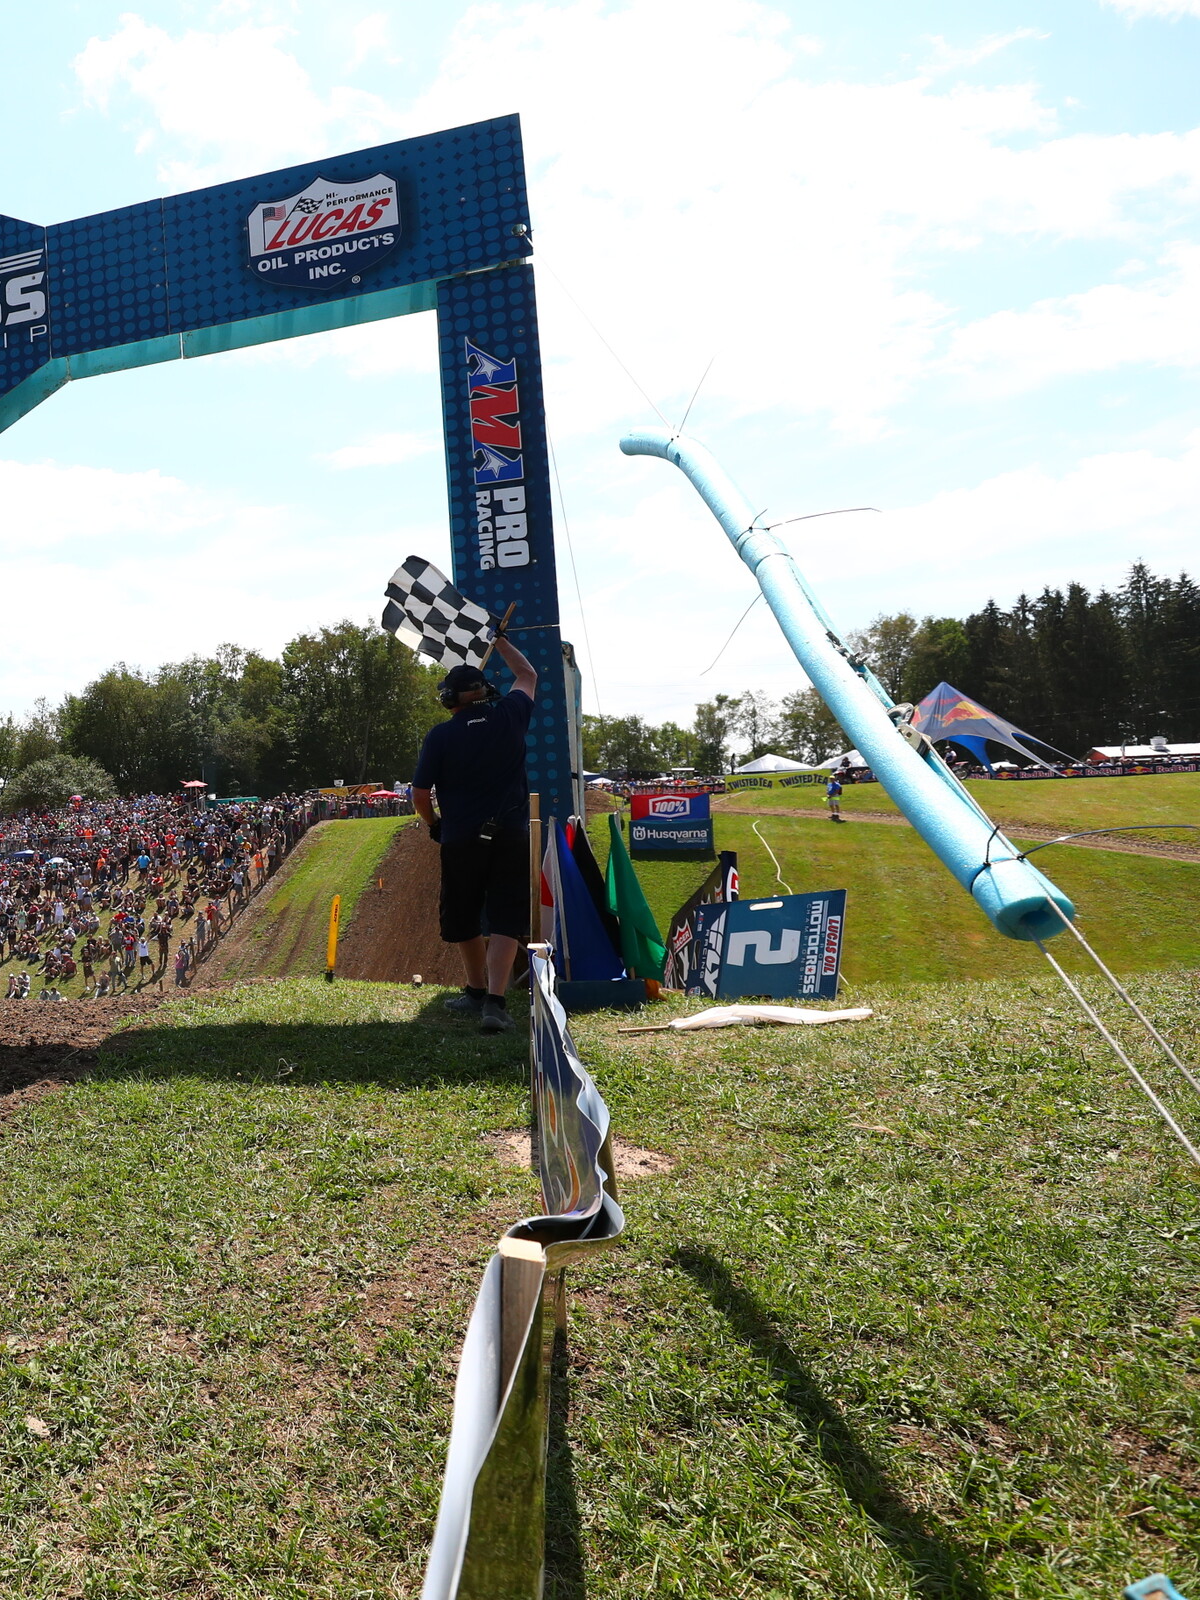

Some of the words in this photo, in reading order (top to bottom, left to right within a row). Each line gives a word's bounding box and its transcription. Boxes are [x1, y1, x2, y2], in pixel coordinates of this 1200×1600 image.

[326, 186, 394, 208] PERFORMANCE
[265, 197, 391, 251] LUCAS
[257, 257, 289, 273] OIL
[294, 232, 395, 265] PRODUCTS
[308, 262, 347, 280] INC.
[464, 336, 525, 485] AMA
[475, 490, 496, 571] RACING
[493, 485, 530, 569] PRO
[728, 778, 759, 790] TWISTED
[759, 777, 773, 789] TEA
[779, 774, 813, 788] TWISTED
[813, 773, 829, 785] TEA
[654, 801, 685, 813] 100%
[647, 828, 708, 840] Husqvarna
[699, 929, 710, 979] RACING
[726, 928, 801, 967] 2
[797, 903, 812, 995] CHAMPIONSHIP
[802, 900, 824, 994] MOTOCROSS
[825, 918, 840, 954] LUCAS
[823, 955, 836, 973] OIL
